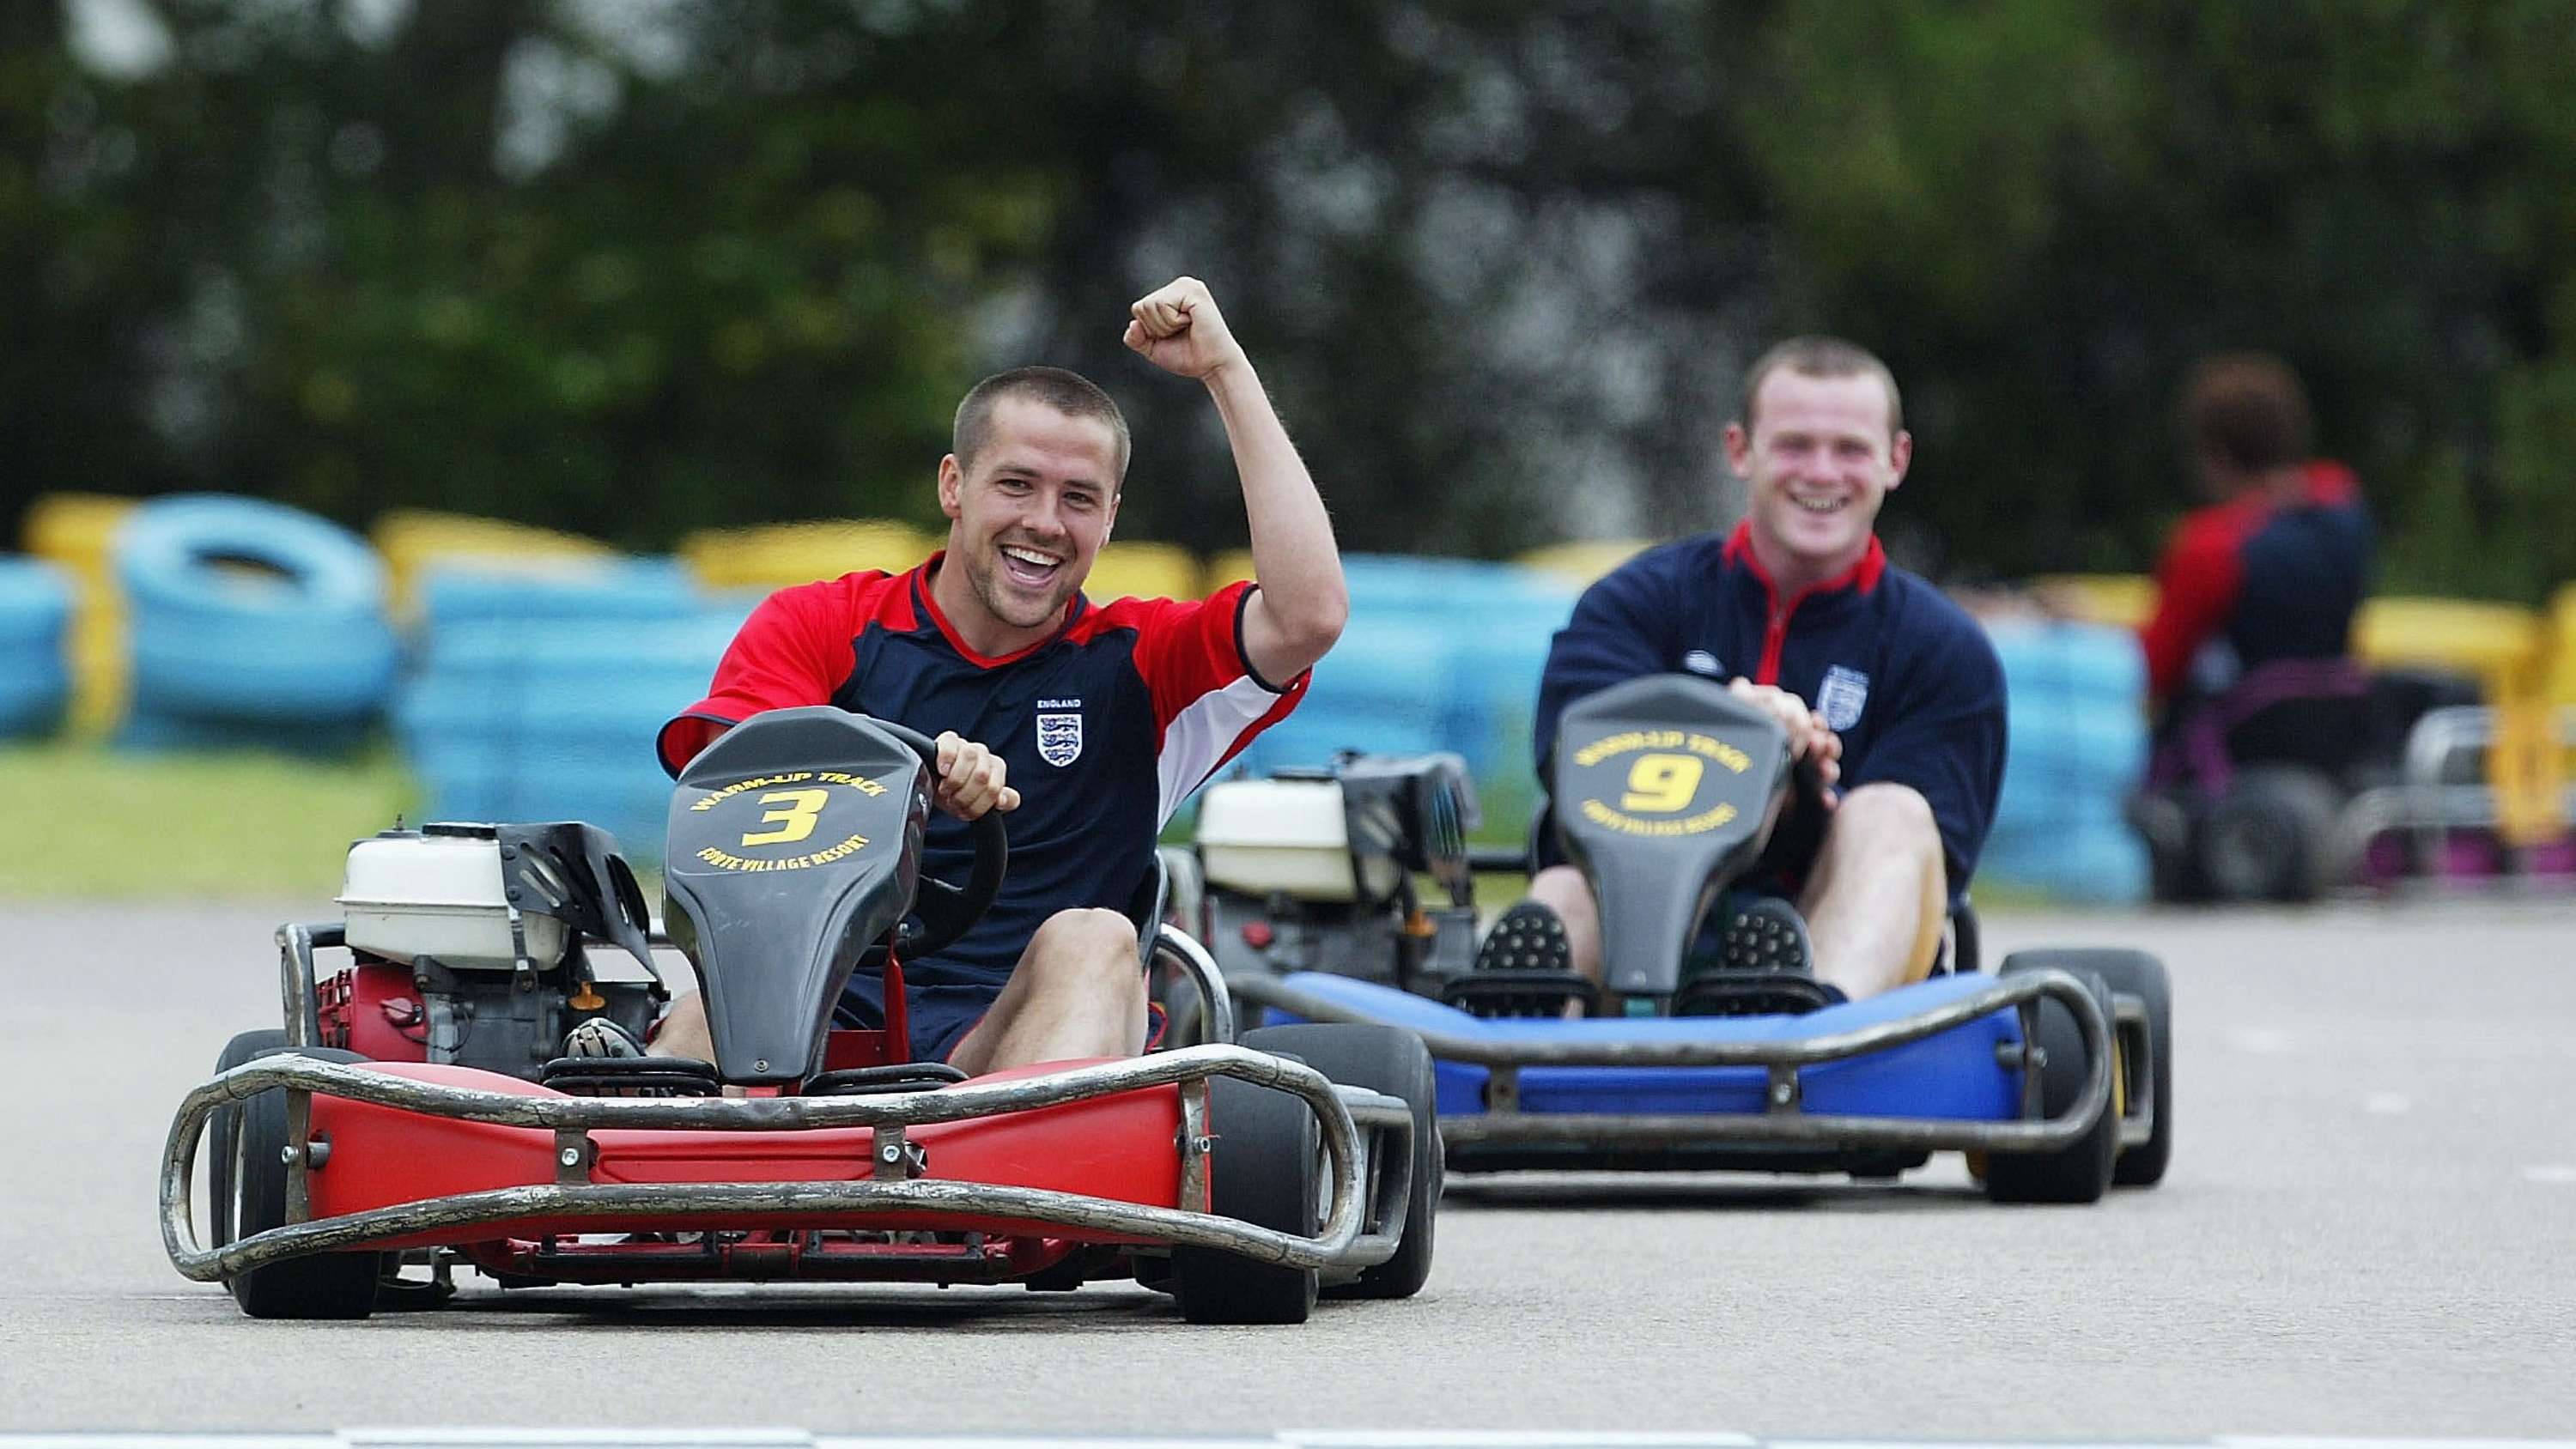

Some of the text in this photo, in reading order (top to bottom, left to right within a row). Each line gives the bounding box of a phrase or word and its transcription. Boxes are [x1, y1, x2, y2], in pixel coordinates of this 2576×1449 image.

[1037, 699, 1081, 708] ENGLAND
[690, 772, 888, 811] WARM-UP TRACK
[1620, 753, 1704, 812] 9
[741, 788, 829, 847] 3
[696, 834, 870, 871] FORTE VILLAGE RESORT
